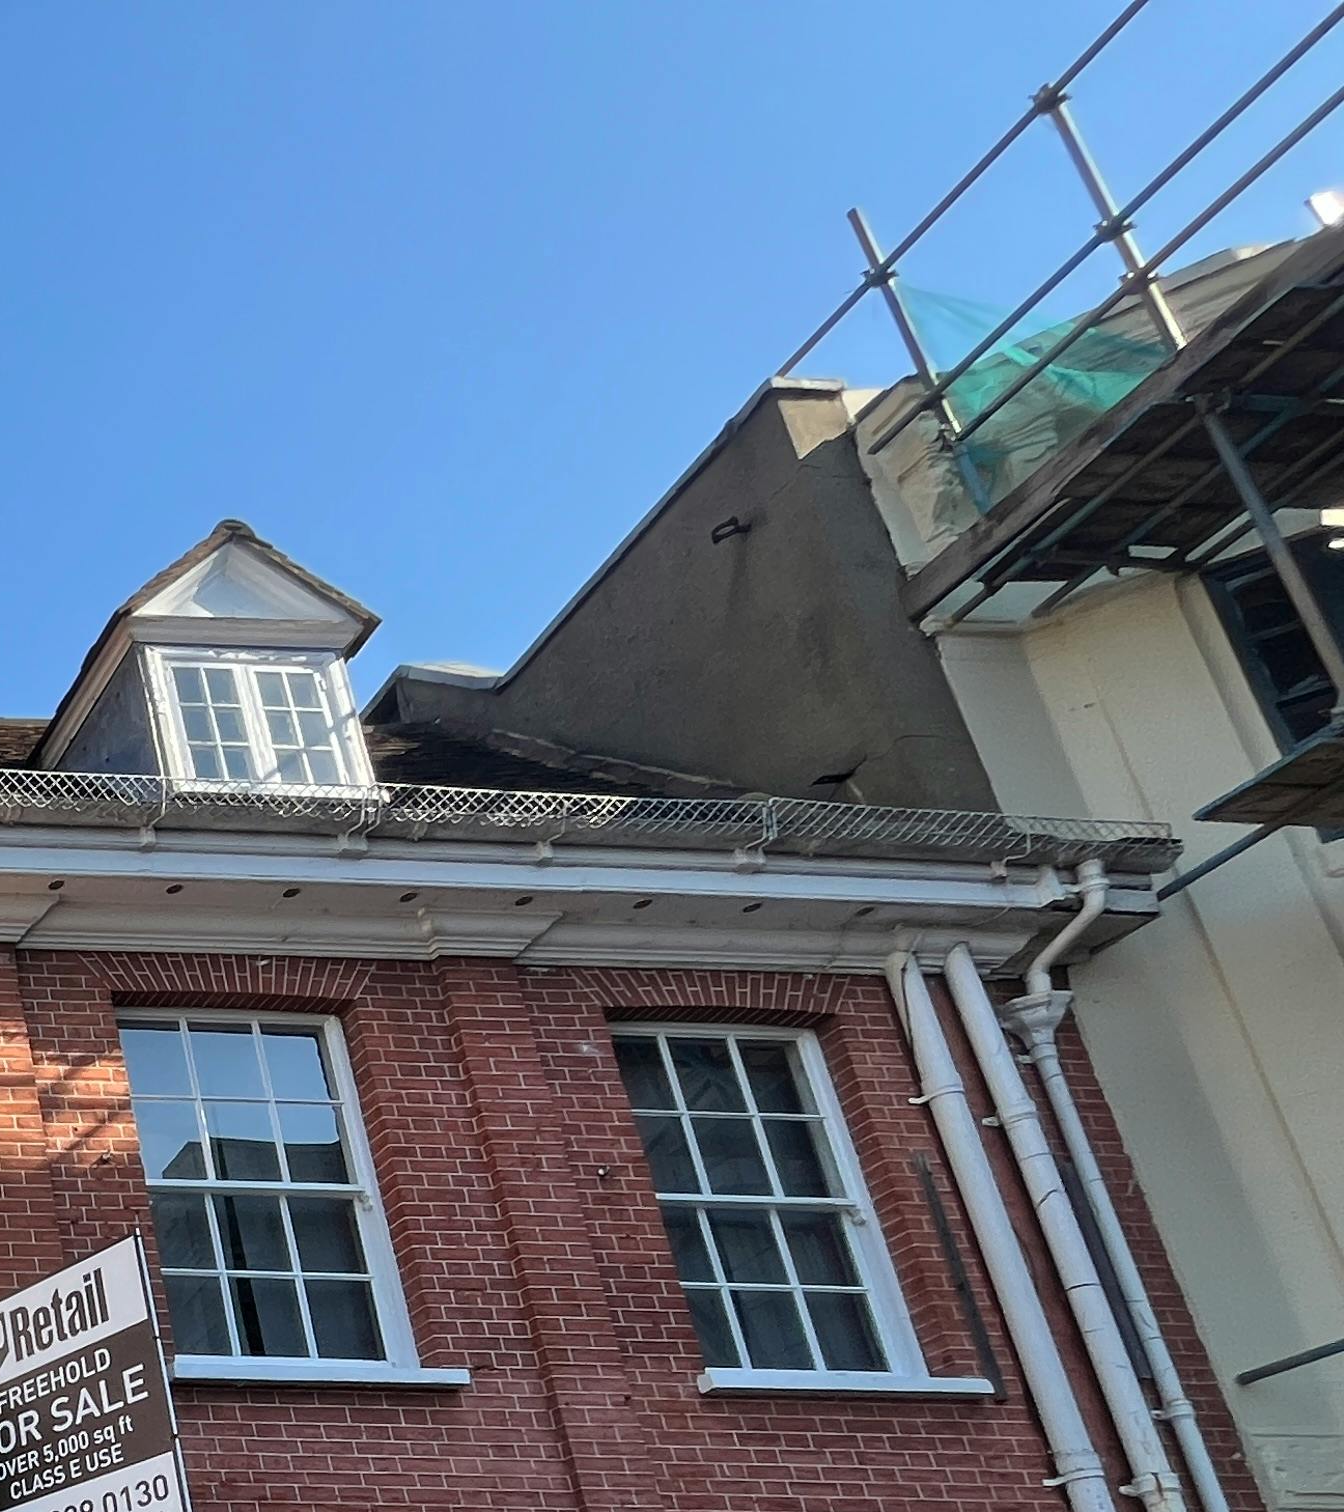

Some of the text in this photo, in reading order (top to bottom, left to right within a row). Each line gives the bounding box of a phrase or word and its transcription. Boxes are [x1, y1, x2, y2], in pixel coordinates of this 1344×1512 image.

[9, 1267, 110, 1362] Retail
[50, 1363, 149, 1433] SALE
[10, 1442, 124, 1500] CLASS E USE
[42, 1430, 89, 1464] 5,000
[93, 1425, 116, 1443] sq
[118, 1414, 134, 1436] ft
